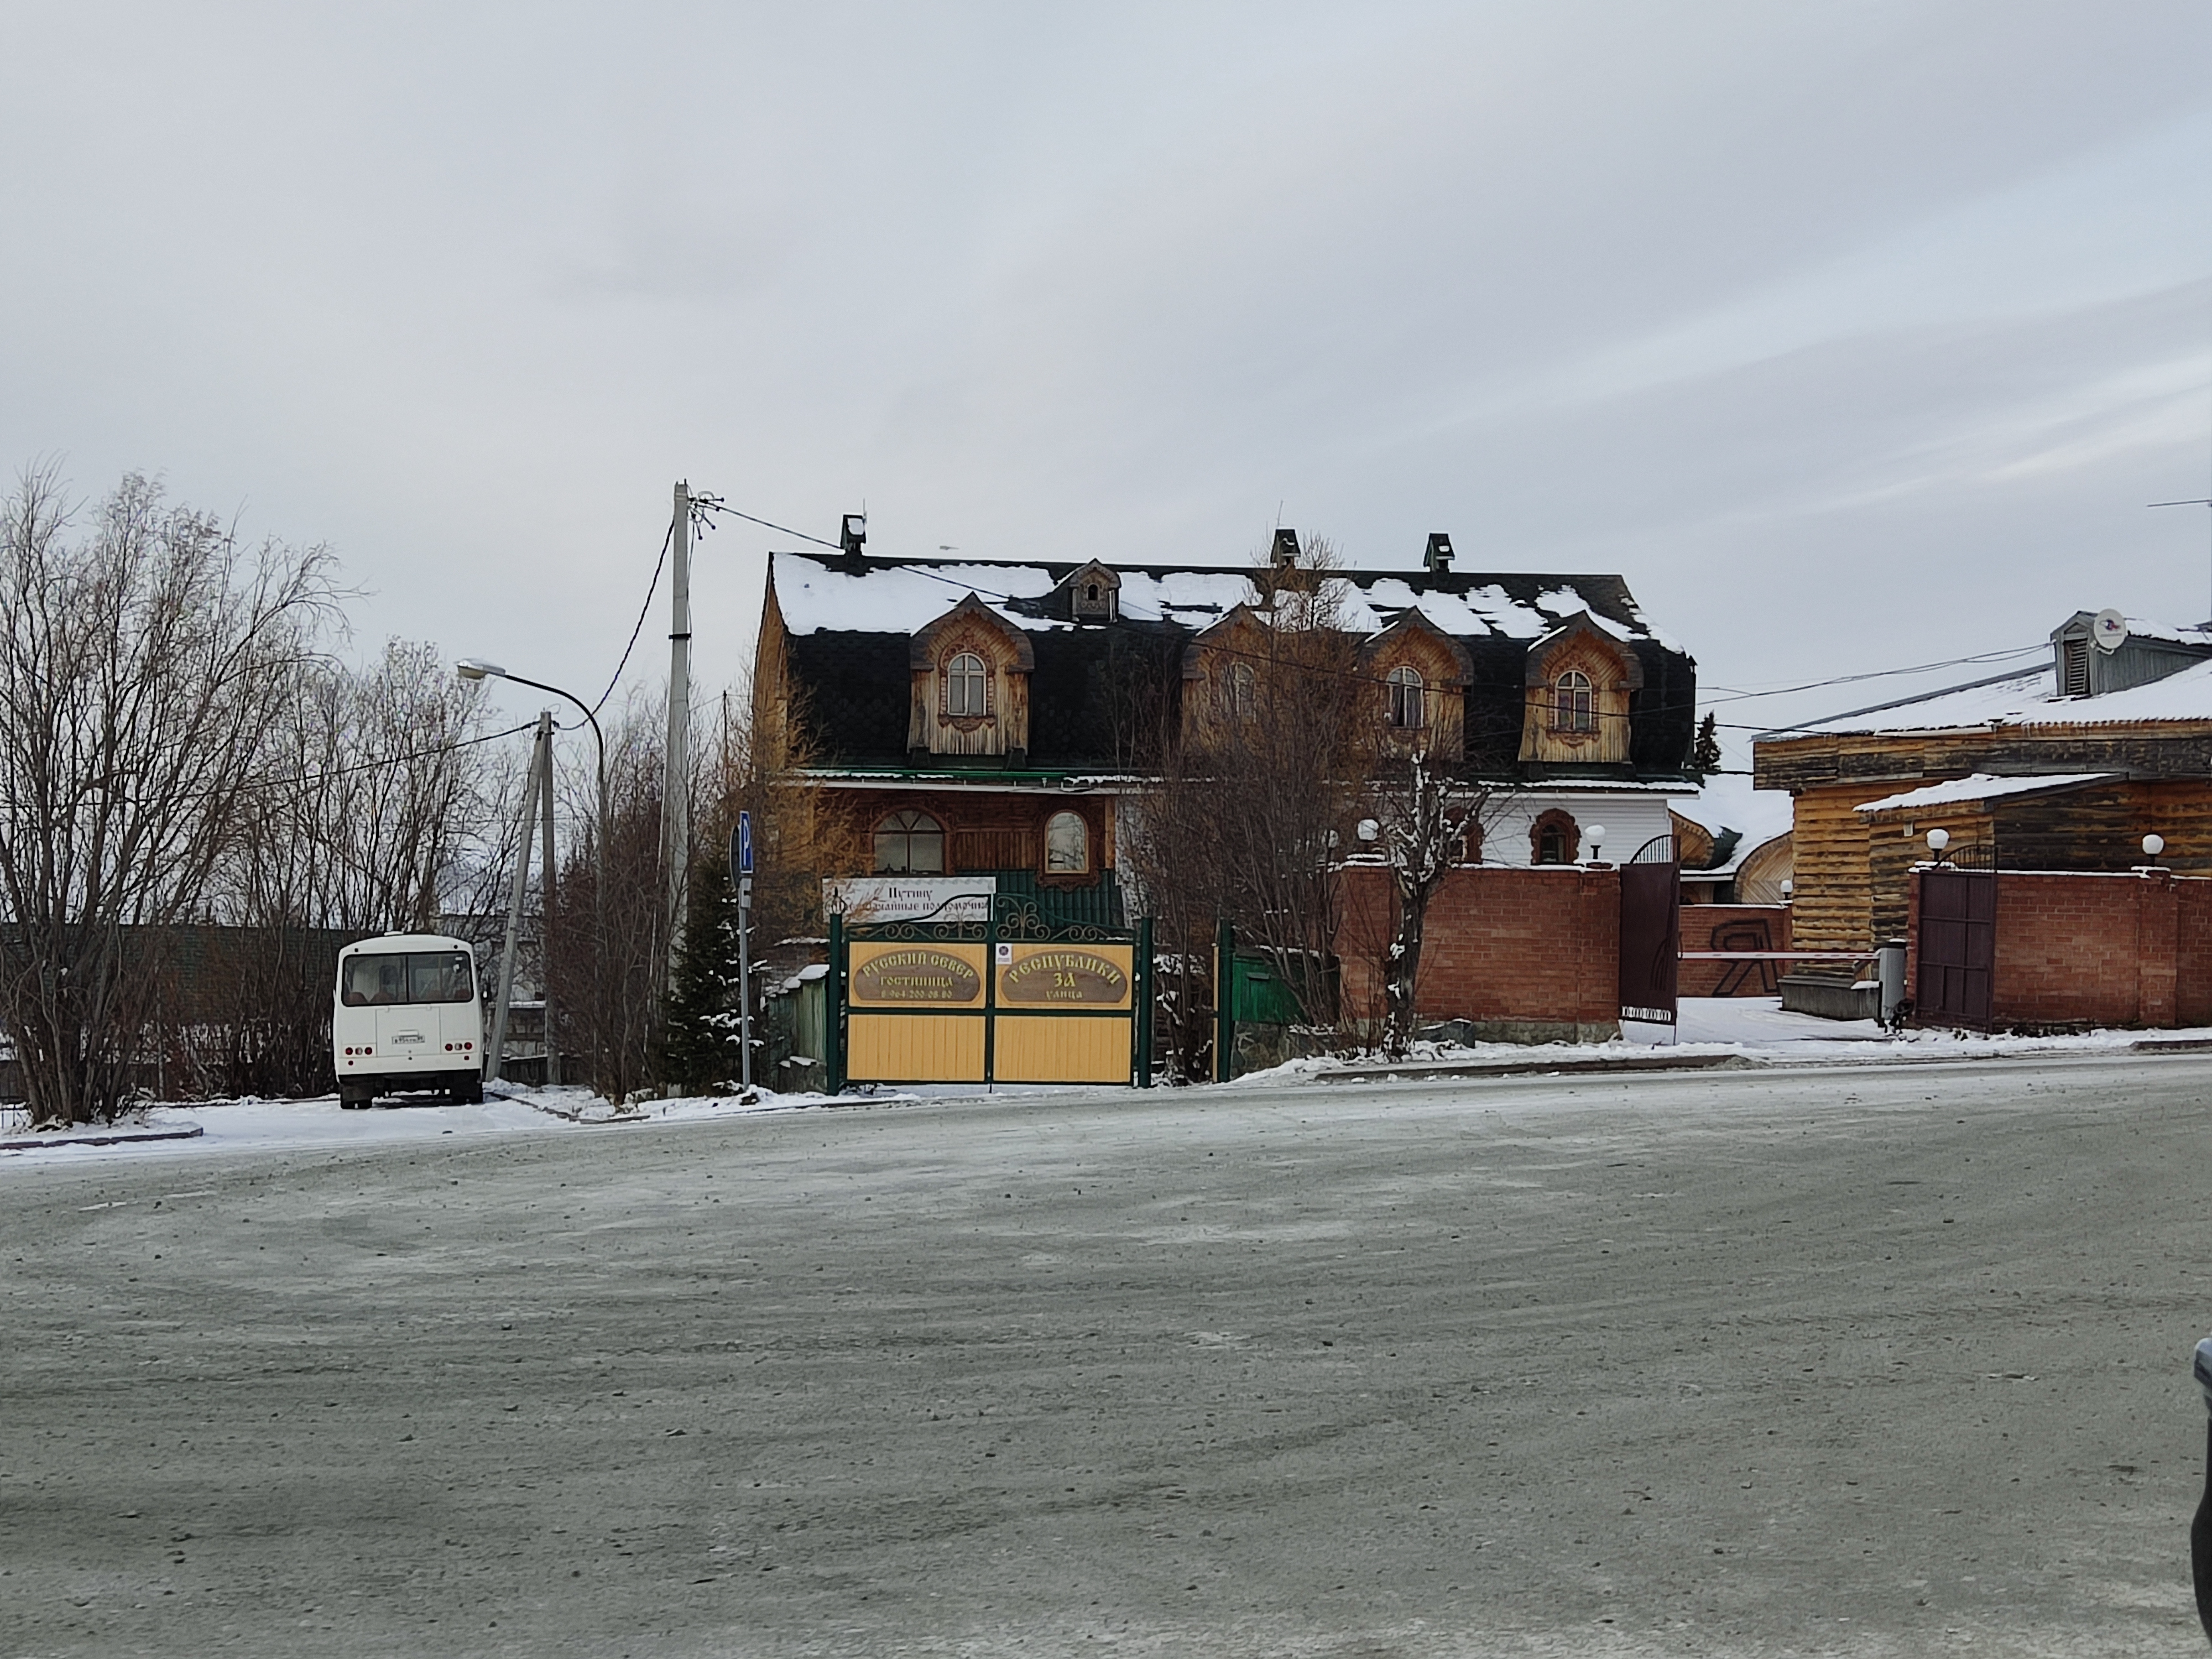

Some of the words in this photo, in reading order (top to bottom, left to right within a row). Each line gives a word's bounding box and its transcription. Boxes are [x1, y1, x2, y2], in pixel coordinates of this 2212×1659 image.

[743, 818, 750, 867] P
[889, 887, 933, 901] Путину
[862, 952, 927, 977] РУССКИЙ
[930, 954, 973, 979] СЕВЕР
[1009, 954, 1121, 985] РЕСПУБЛИКИ
[1046, 990, 1083, 1000] улица
